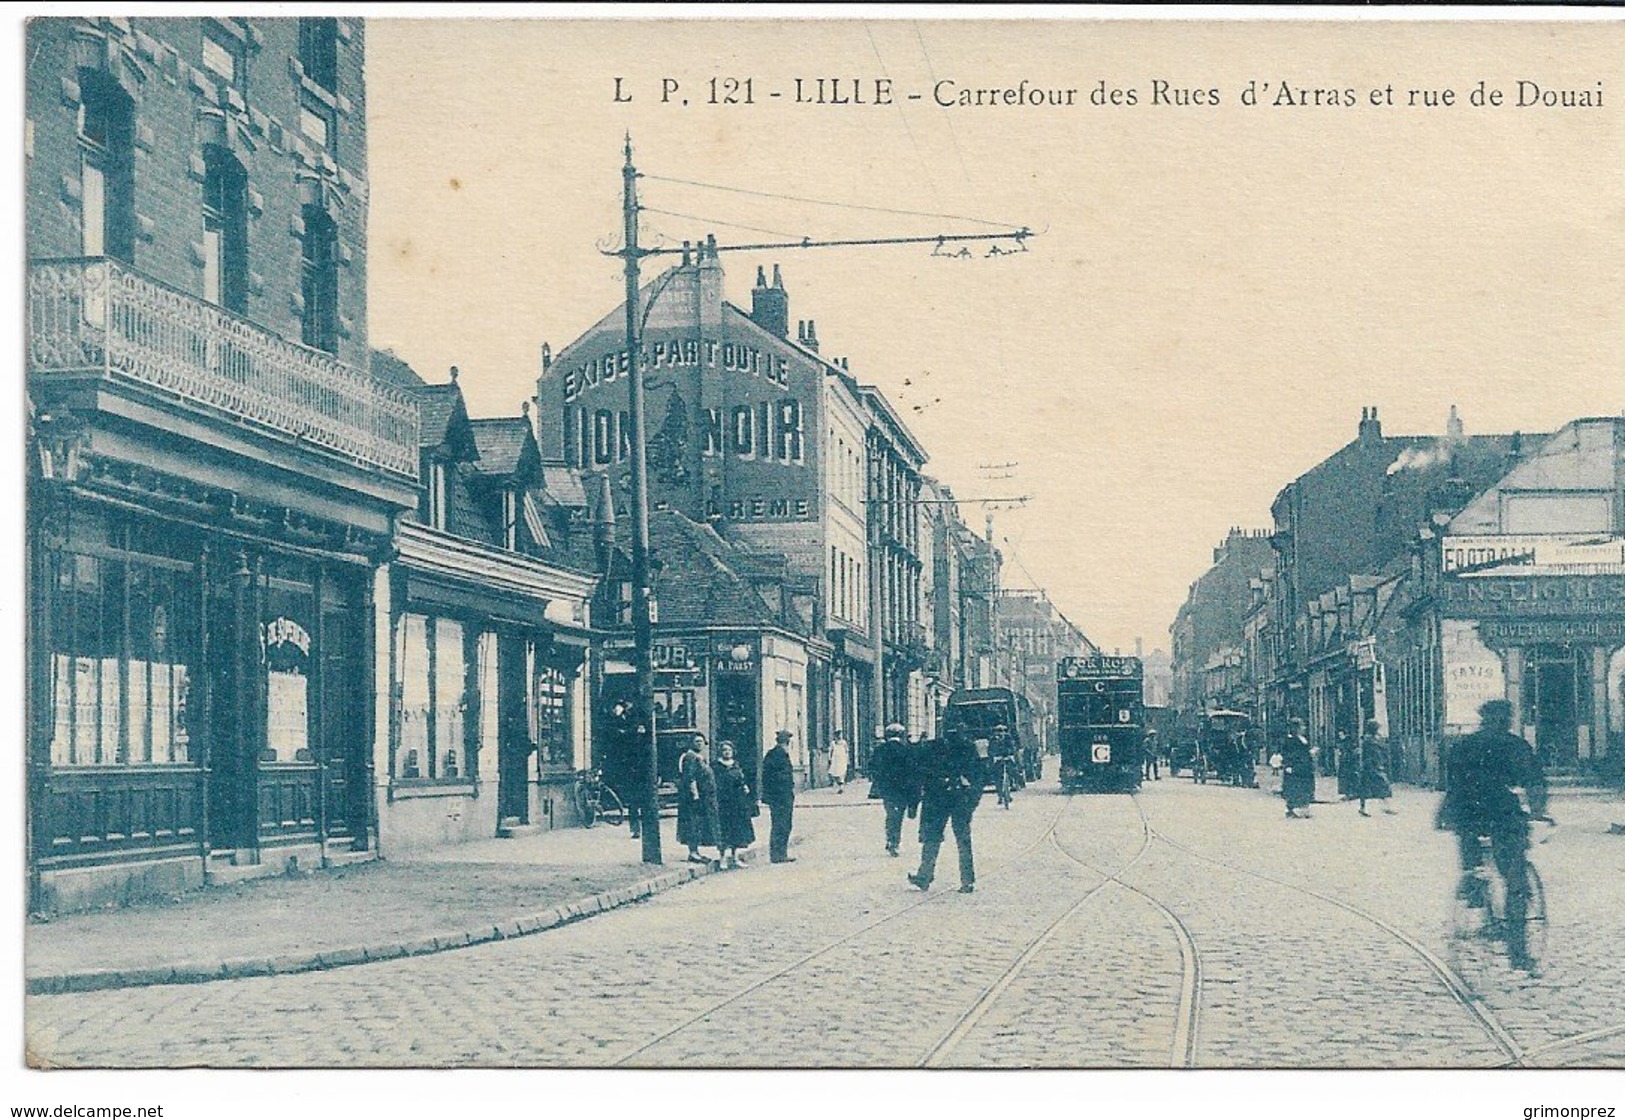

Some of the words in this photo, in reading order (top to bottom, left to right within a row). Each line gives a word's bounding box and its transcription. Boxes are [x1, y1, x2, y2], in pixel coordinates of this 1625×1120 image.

[766, 352, 790, 392] LE
[701, 398, 805, 467] NOIR
[1095, 681, 1105, 692] C
[1093, 746, 1108, 761] C
